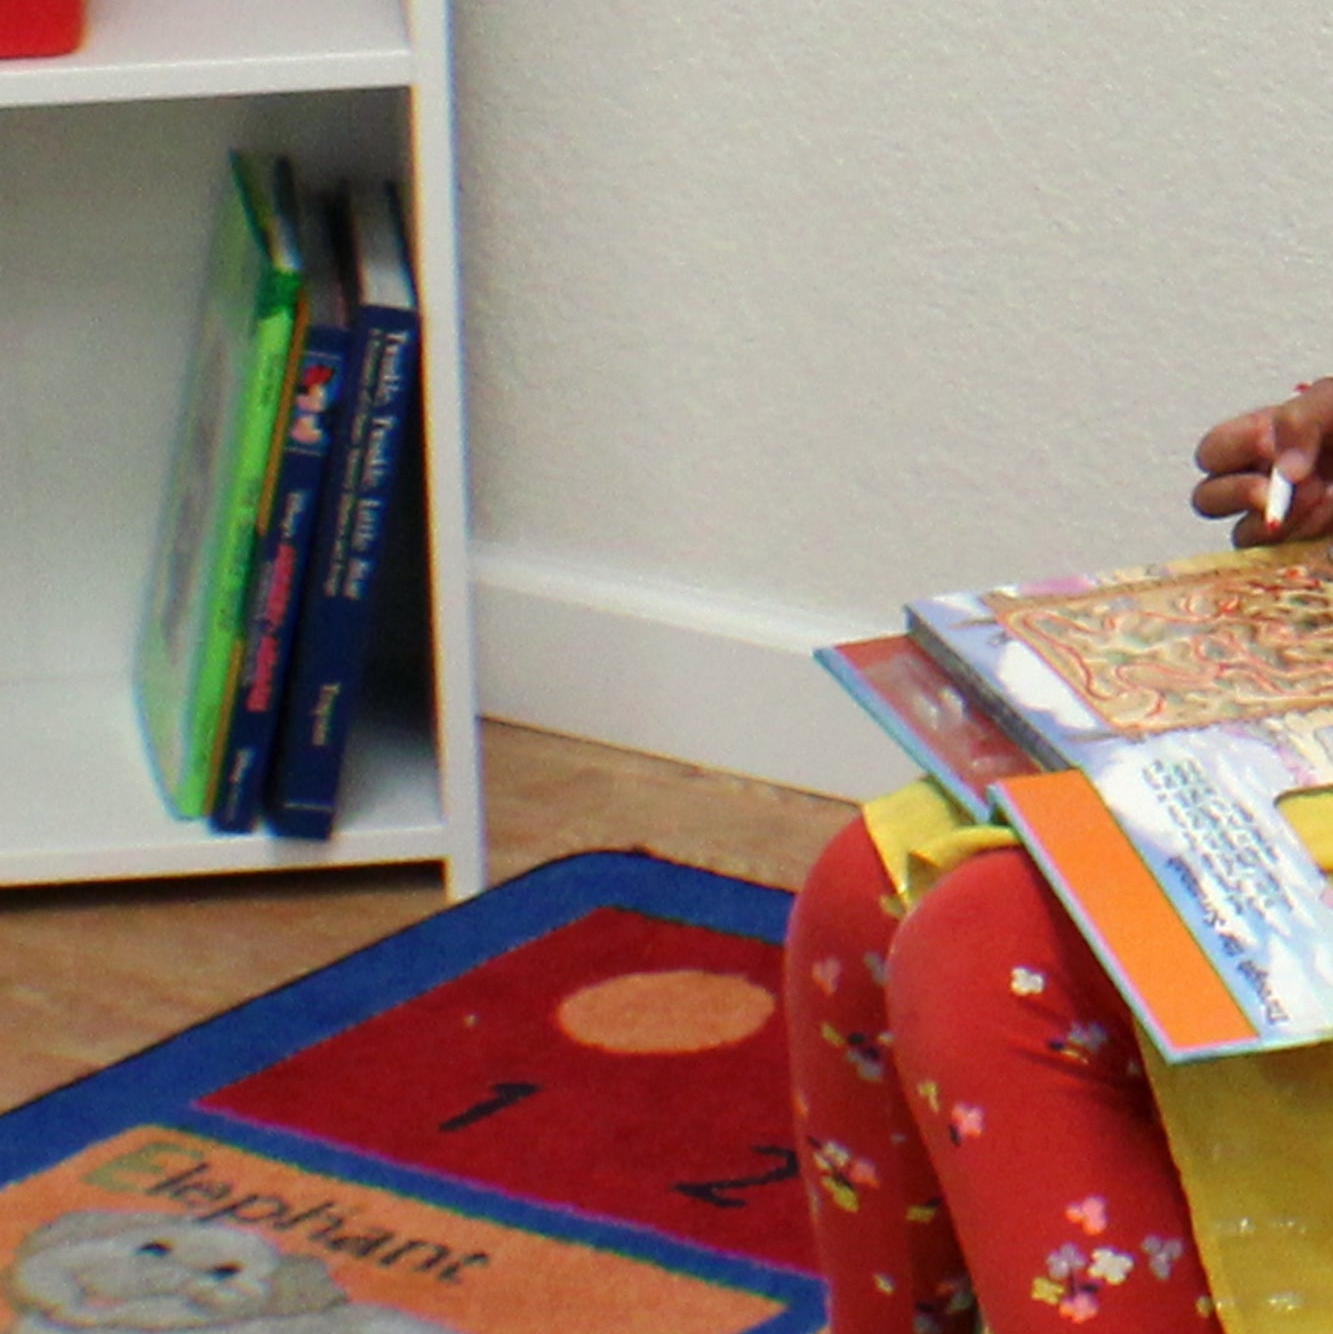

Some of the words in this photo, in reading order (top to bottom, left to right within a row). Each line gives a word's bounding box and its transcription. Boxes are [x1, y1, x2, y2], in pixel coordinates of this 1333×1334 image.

[439, 1082, 543, 1133] 1
[671, 1144, 798, 1208] 2
[80, 1141, 490, 1286] Elephant
